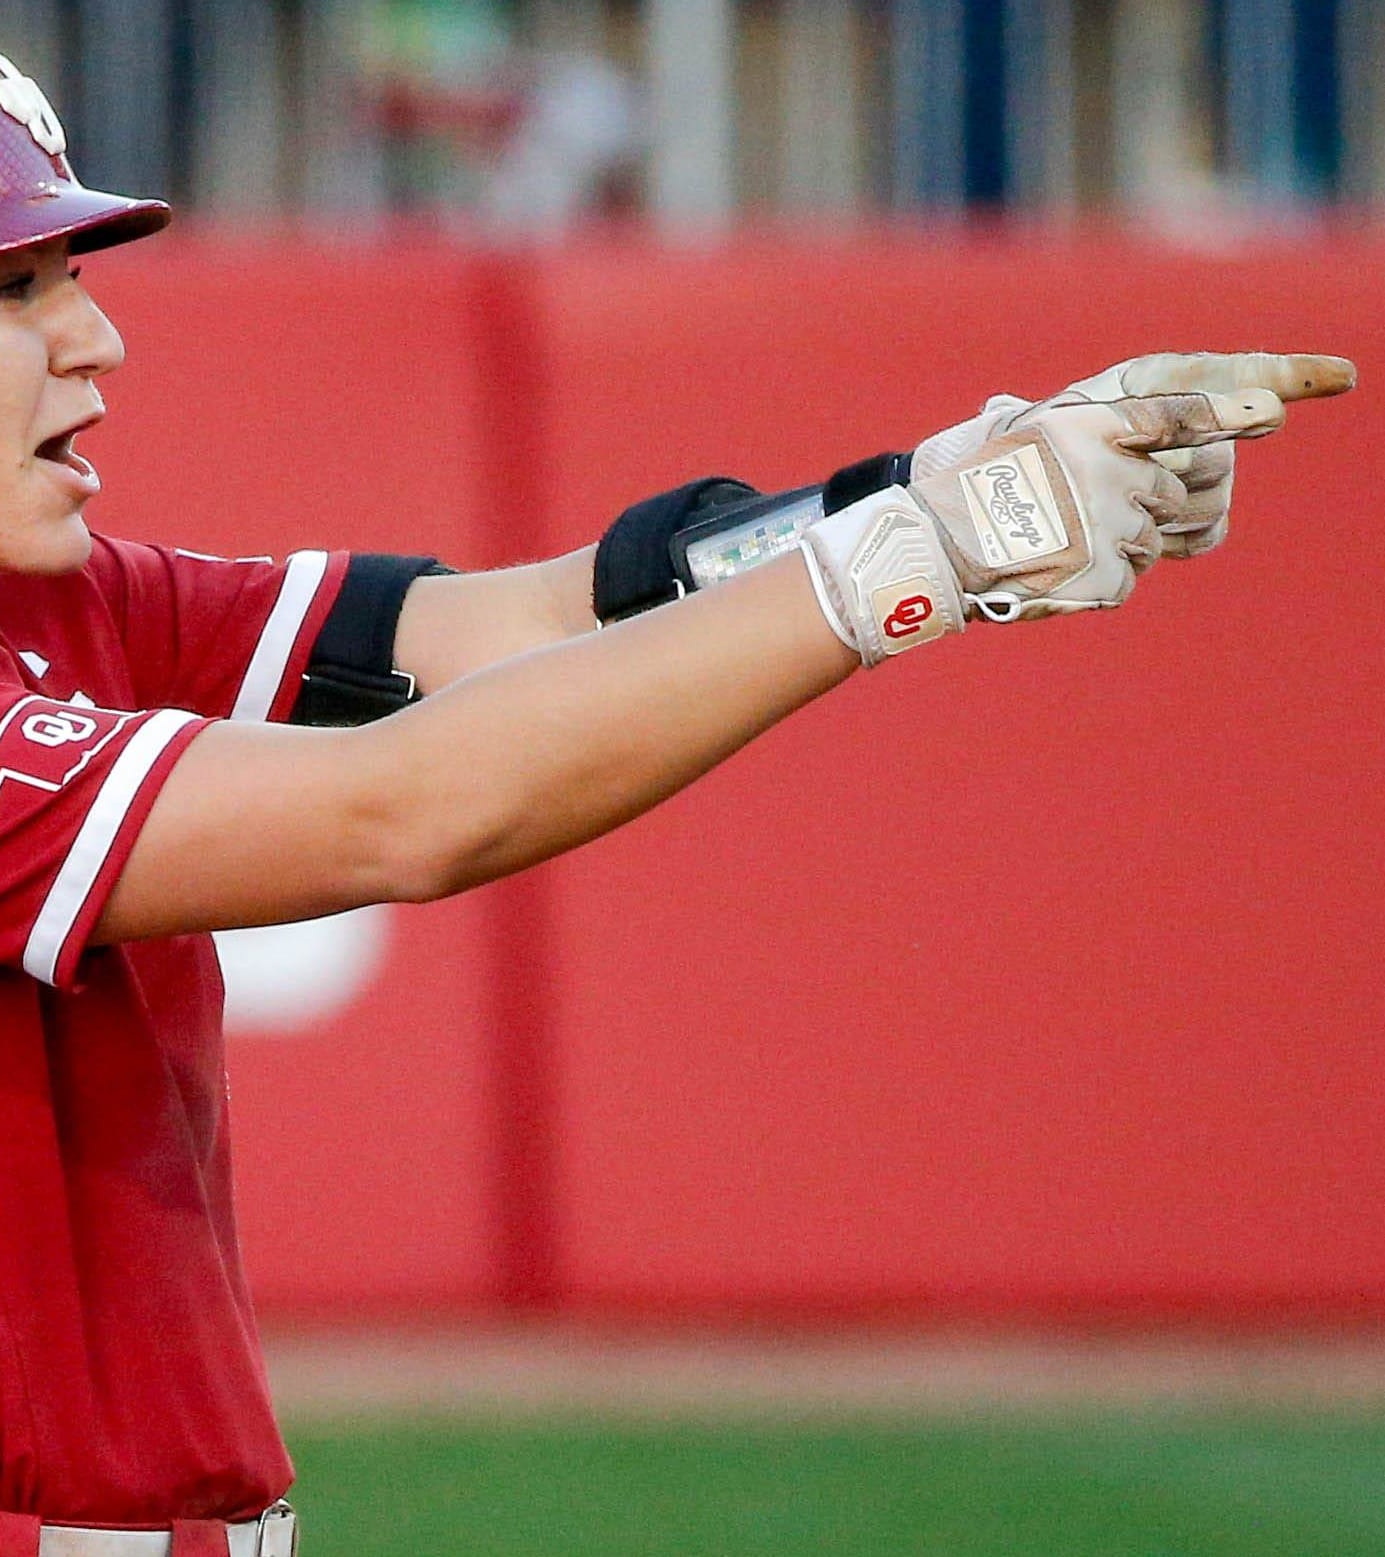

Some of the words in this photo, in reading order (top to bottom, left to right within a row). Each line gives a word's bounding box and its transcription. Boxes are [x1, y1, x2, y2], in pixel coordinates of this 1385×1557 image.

[985, 464, 1043, 548] Rawlings
[883, 594, 933, 638] OU
[20, 709, 98, 747] OU
